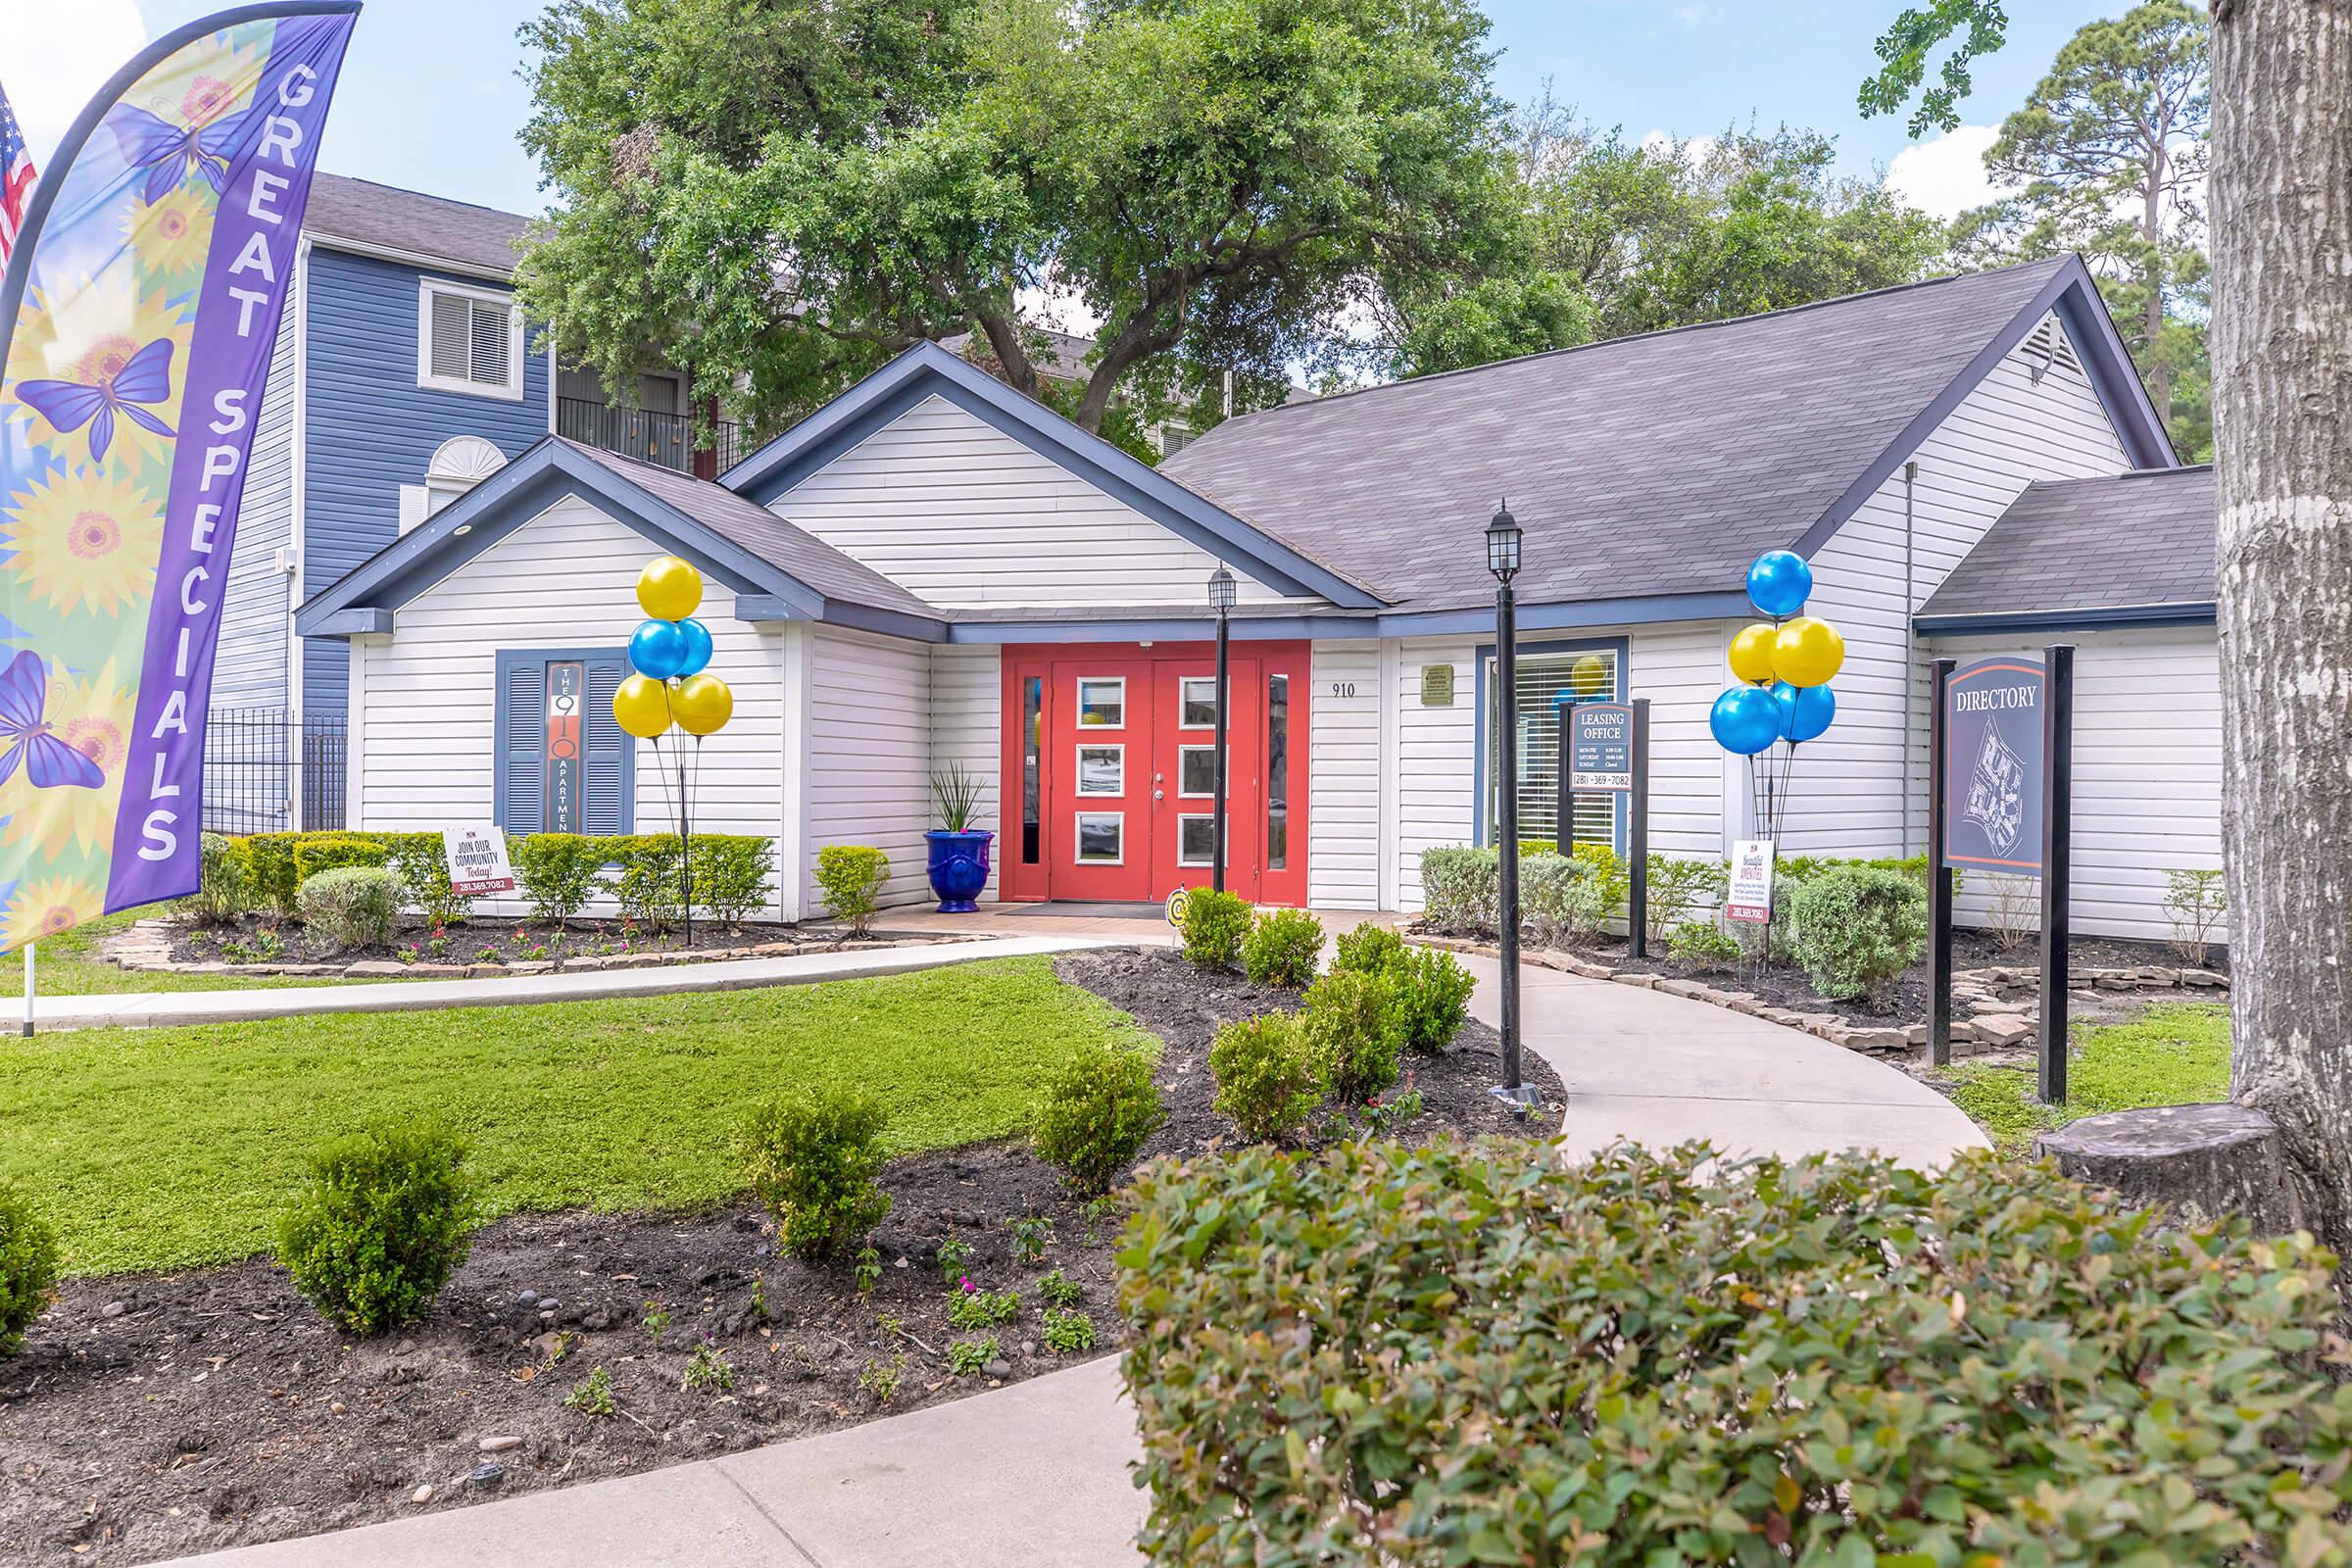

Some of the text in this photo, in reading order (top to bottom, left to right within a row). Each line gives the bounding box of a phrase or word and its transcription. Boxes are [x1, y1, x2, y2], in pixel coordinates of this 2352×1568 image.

[137, 63, 318, 861] GREAT SPECIALS
[1333, 683, 1354, 698] 910
[1956, 686, 2037, 711] DIRECTORY
[1581, 713, 1624, 725] LEASING
[1584, 727, 1621, 739] OFFICE
[552, 669, 575, 831] THE 910 APARTMEN
[458, 840, 491, 855] JOIN OUR
[455, 852, 498, 867] COMMUNITY
[466, 865, 493, 878] Today!
[459, 880, 506, 892] 281.369.7082
